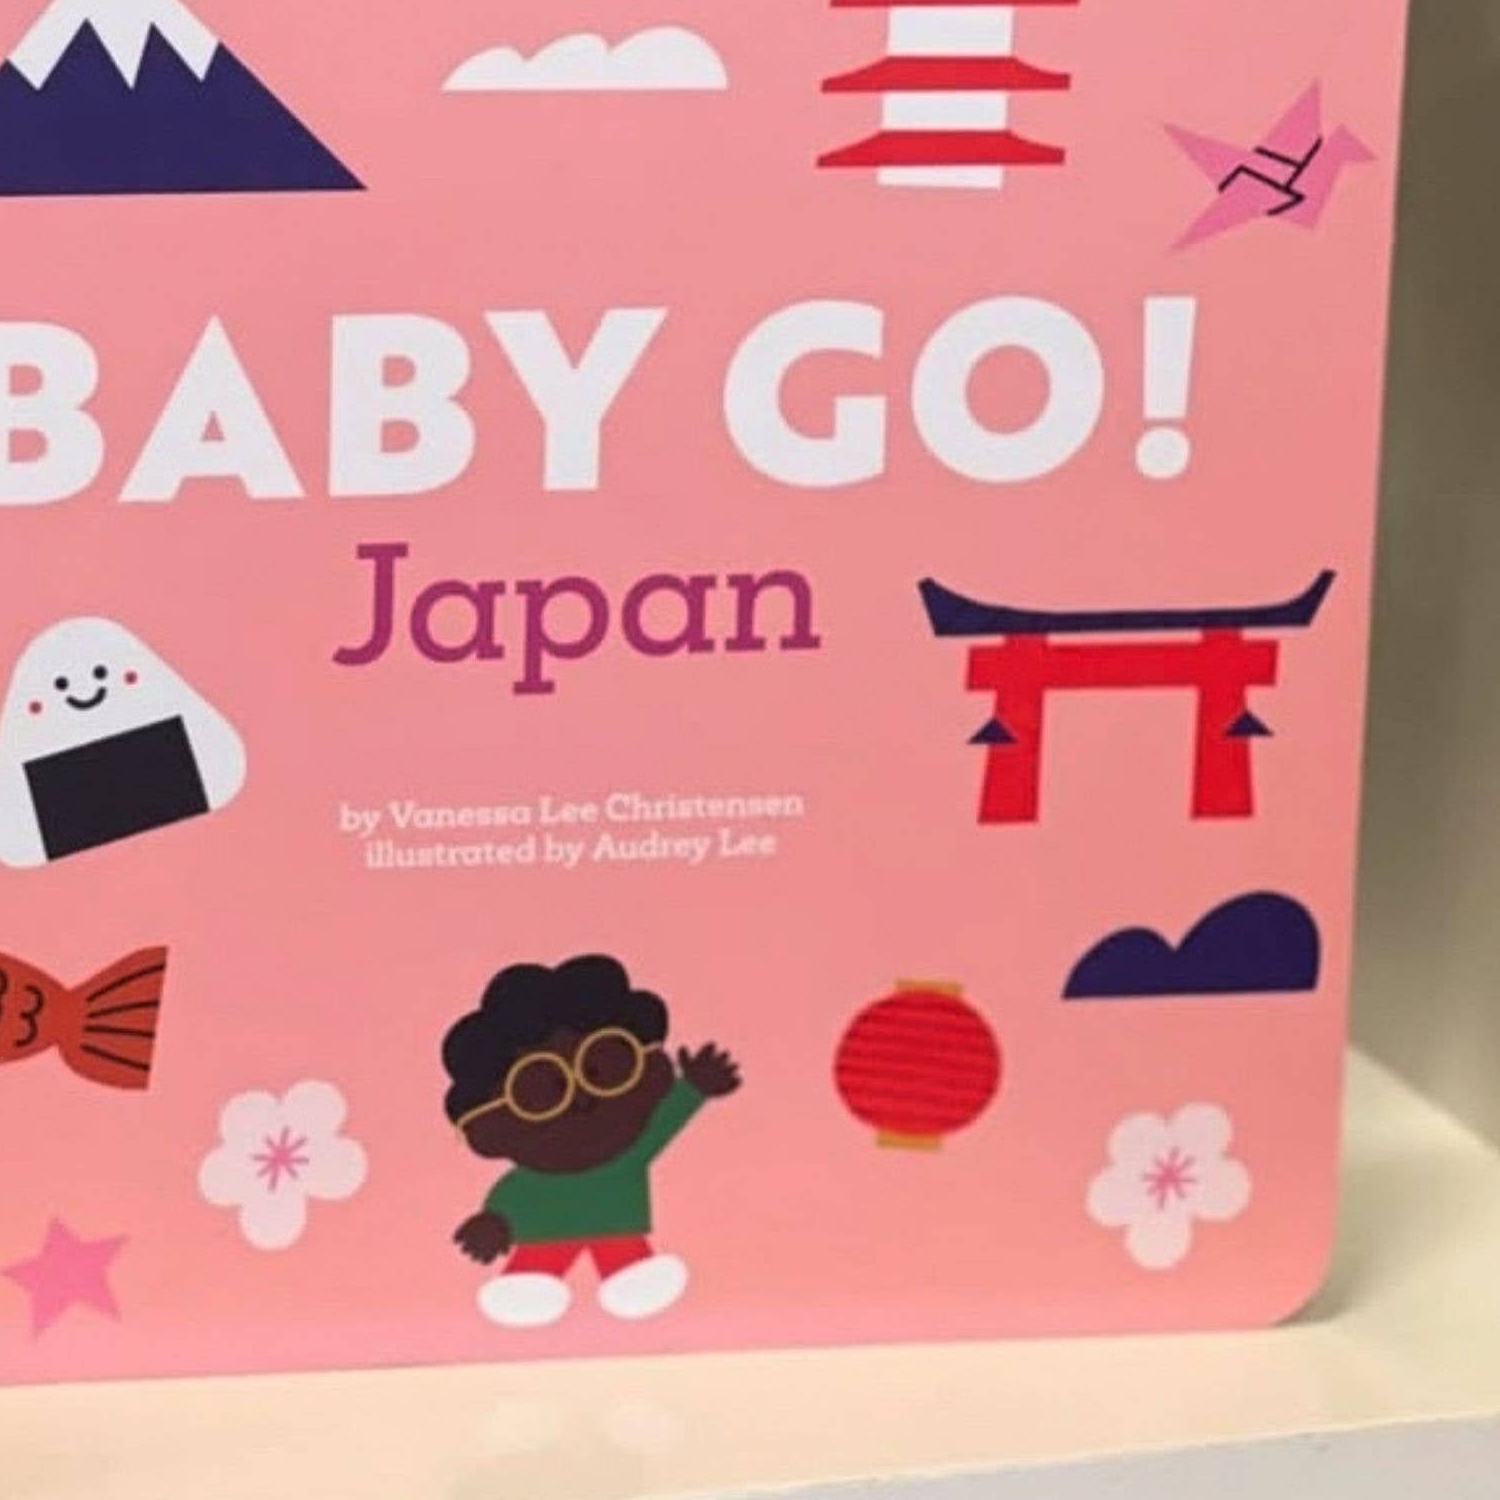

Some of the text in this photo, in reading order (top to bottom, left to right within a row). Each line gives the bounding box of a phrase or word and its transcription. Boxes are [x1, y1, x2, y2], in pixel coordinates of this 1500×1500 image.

[722, 295, 1198, 488] GO!
[332, 540, 821, 695] Japan
[339, 791, 805, 836] by Vanessa Lee Christensen
[365, 827, 777, 869] illustrated by Audrey Lee
